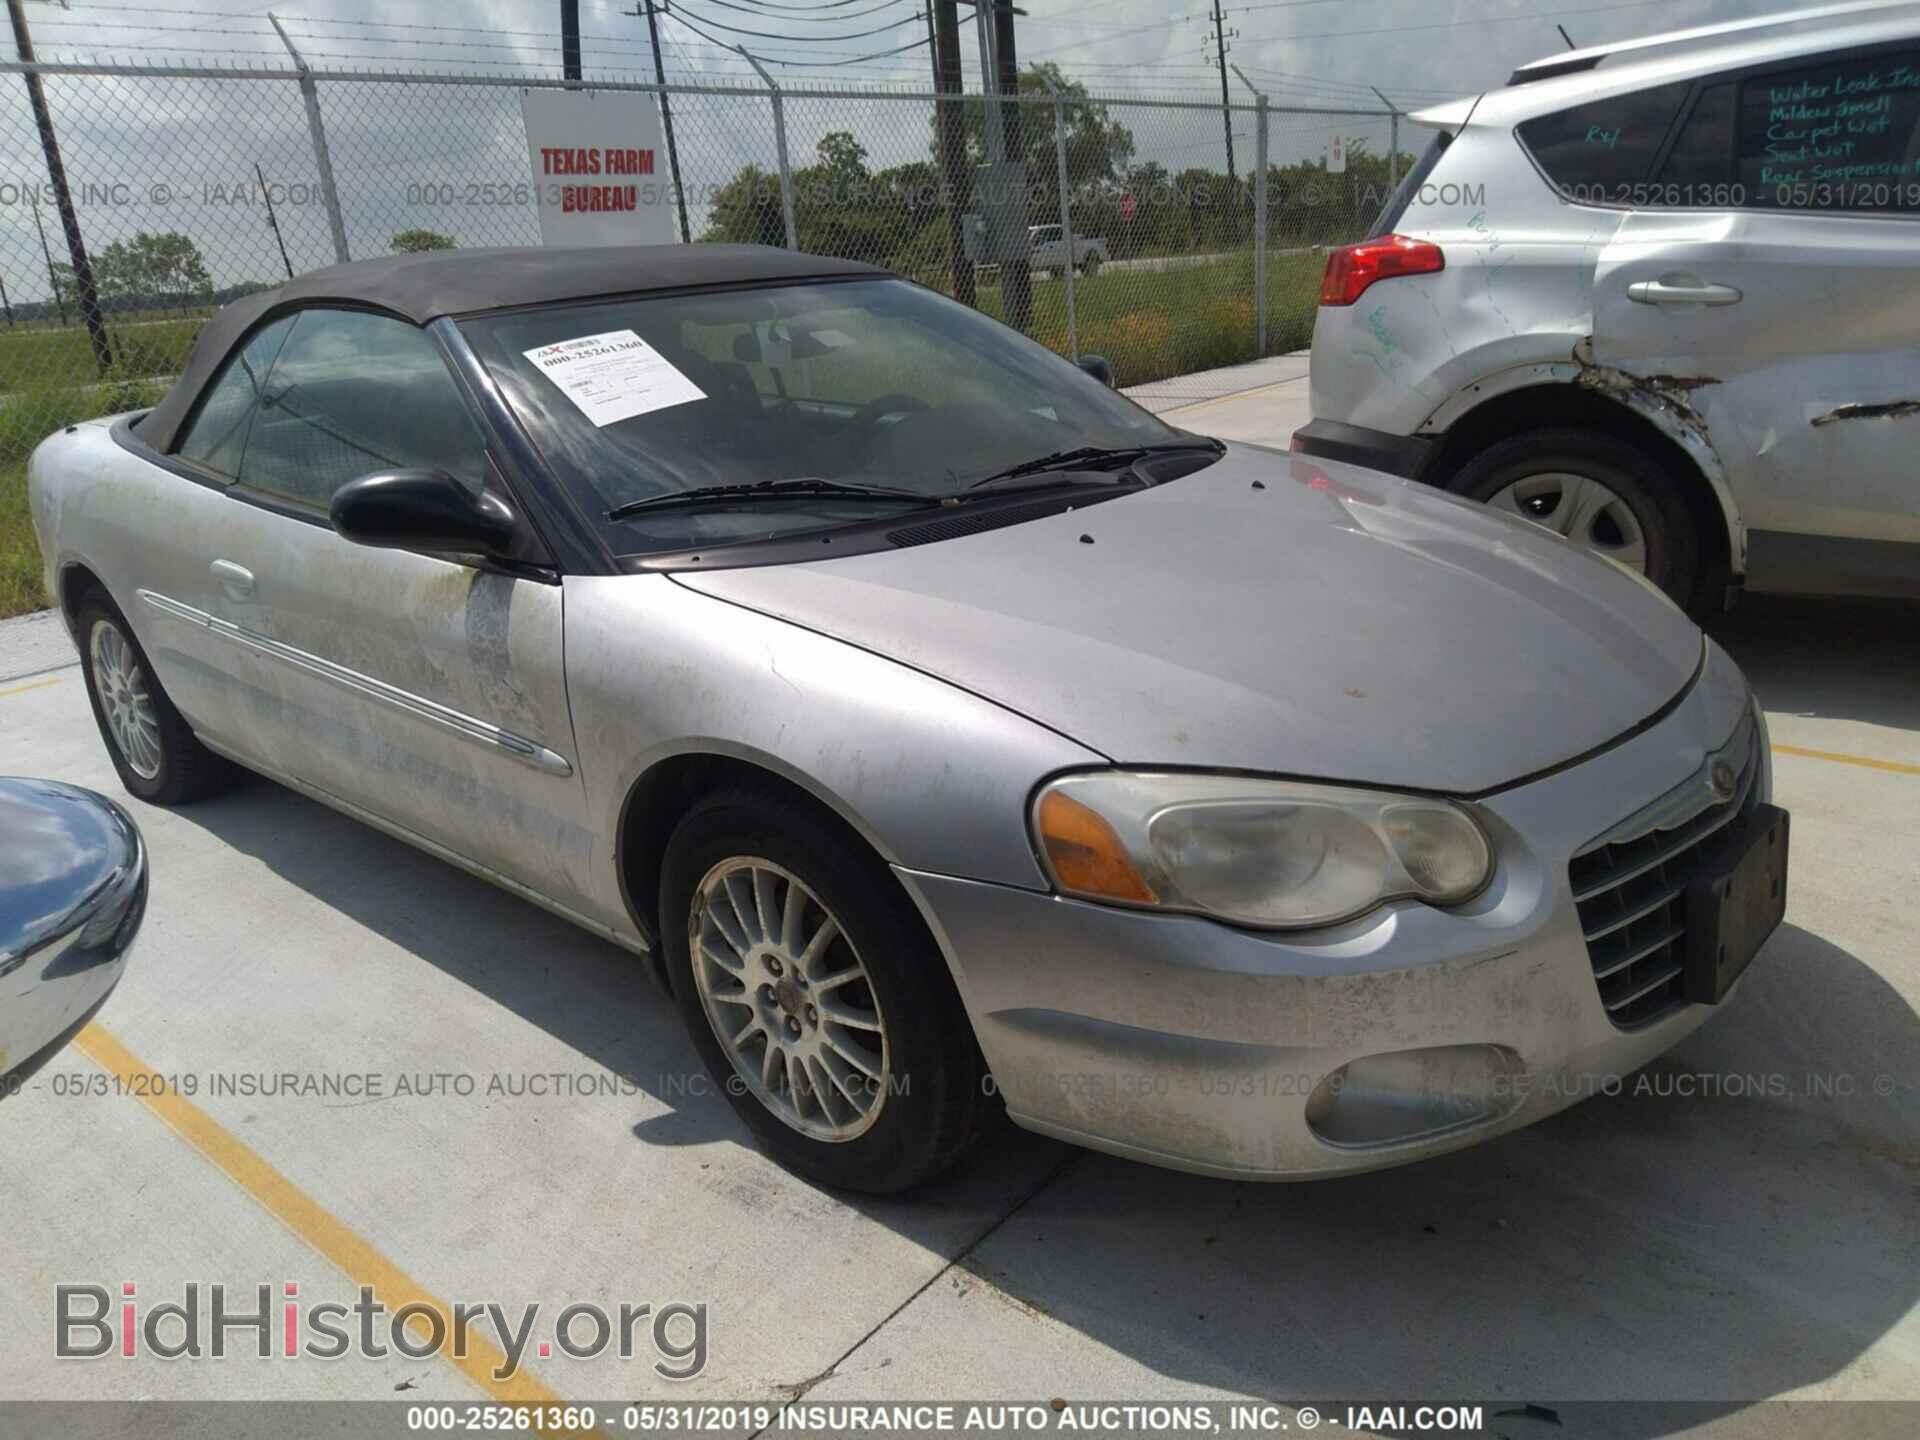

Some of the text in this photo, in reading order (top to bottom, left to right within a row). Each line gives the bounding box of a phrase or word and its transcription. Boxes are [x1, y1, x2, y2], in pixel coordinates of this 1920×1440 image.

[1835, 74, 1880, 95] Leak
[541, 148, 655, 175] TEXAS FARM
[561, 185, 637, 213] BUREAU
